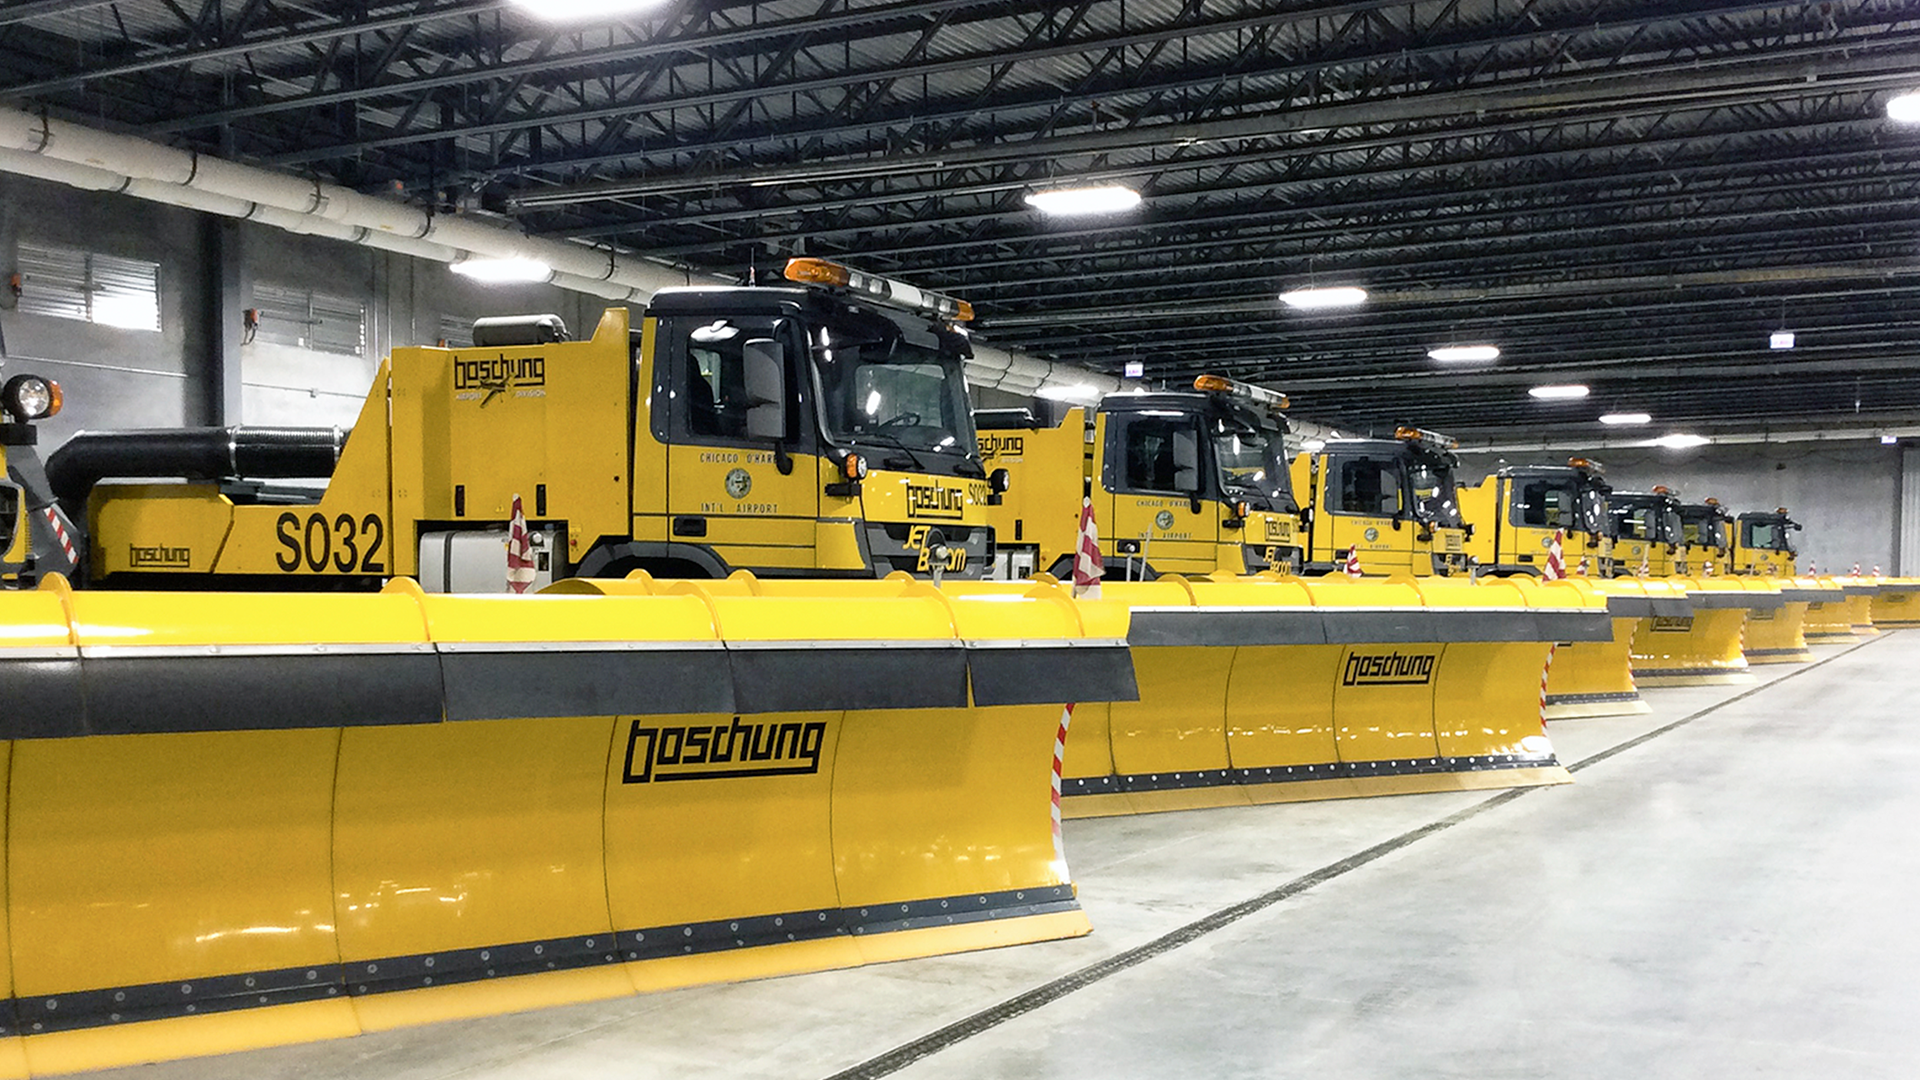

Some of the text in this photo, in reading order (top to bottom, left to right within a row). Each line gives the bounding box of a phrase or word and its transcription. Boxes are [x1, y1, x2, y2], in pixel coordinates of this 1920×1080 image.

[455, 353, 545, 389] boschung
[977, 433, 1023, 456] schung
[700, 453, 739, 463] CHICAGO
[701, 502, 778, 513] INT'L AIRPORT
[275, 512, 384, 573] S032
[902, 525, 931, 550] JET
[916, 547, 966, 572] BOM
[1343, 651, 1435, 686] boschung
[622, 717, 827, 784] boschung
